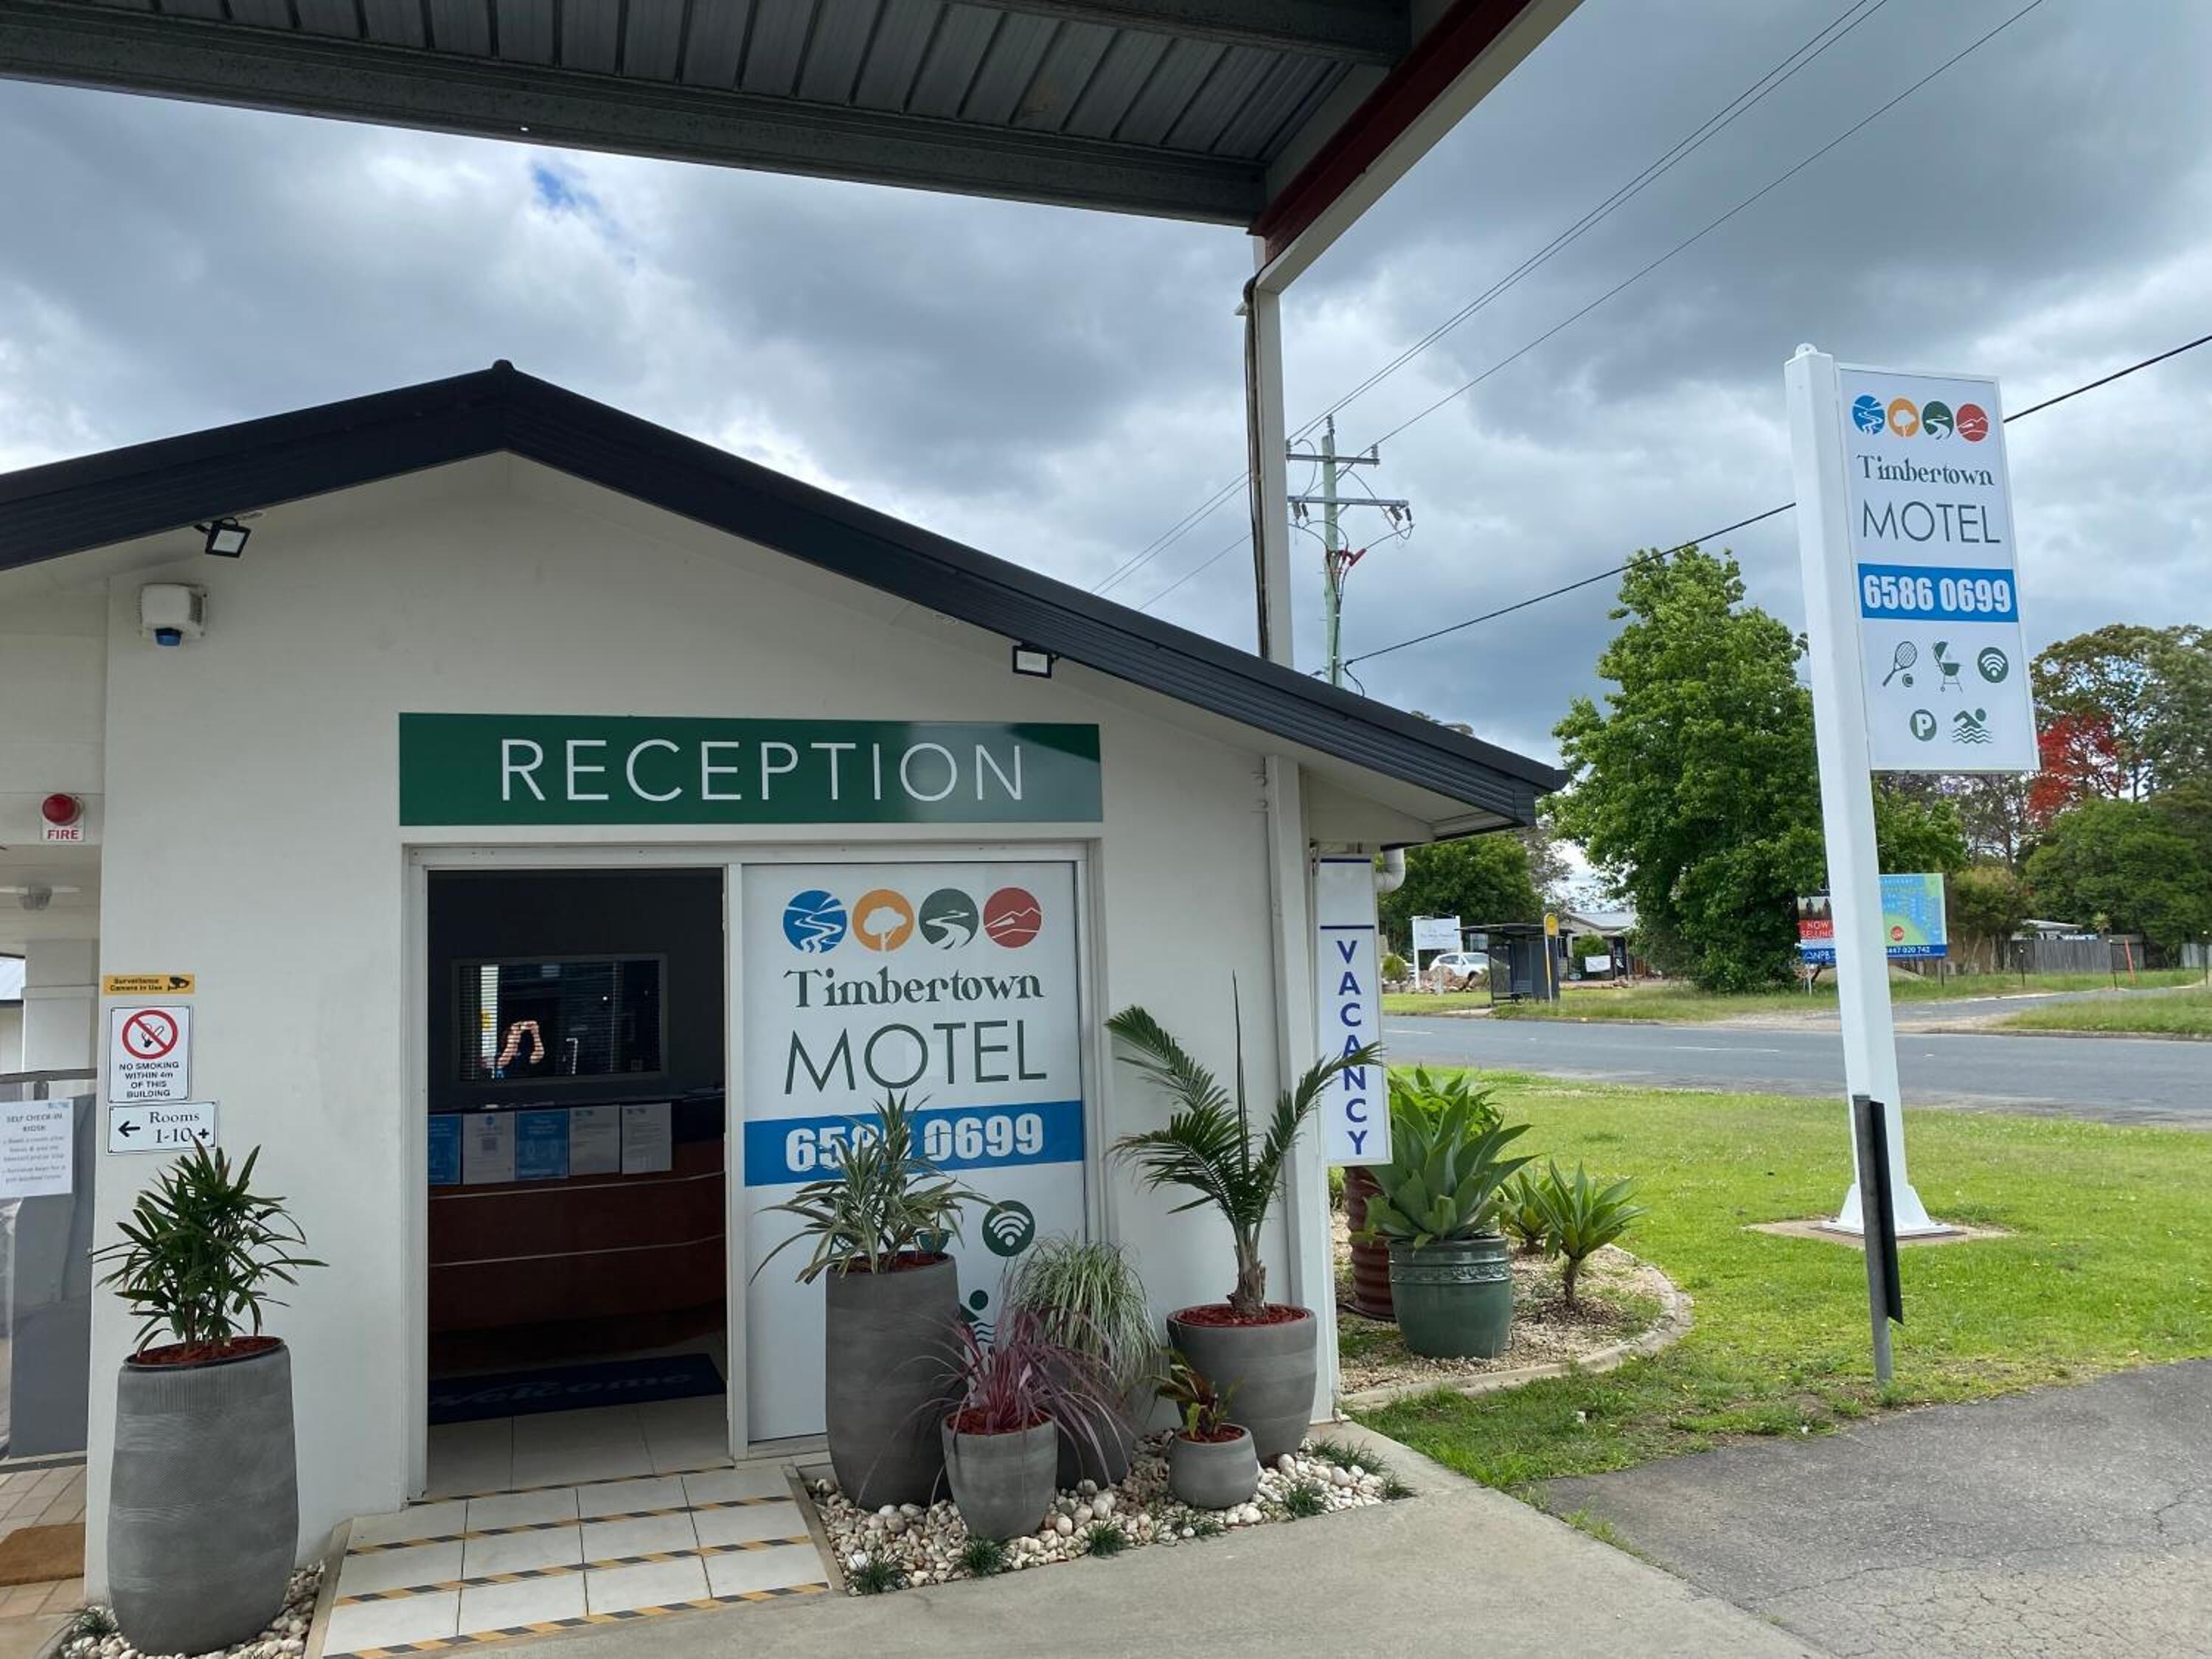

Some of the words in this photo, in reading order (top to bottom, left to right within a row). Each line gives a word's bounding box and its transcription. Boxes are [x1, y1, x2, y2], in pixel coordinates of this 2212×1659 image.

[1857, 454, 1994, 487] Timbertown
[1863, 499, 2001, 543] MOTEL
[1863, 574, 1933, 611] 6586
[1939, 578, 2011, 613] 0699
[1916, 714, 1931, 737] P
[501, 739, 1023, 801] RECEPTION
[47, 830, 79, 840] FIRE
[783, 967, 1044, 1008] Timbertown
[784, 1019, 1047, 1095] MOTEL
[1336, 939, 1368, 1156] VACANCY
[119, 1062, 133, 1071] NO
[136, 1061, 179, 1070] SMOKING
[126, 1089, 170, 1098] BUILDING
[131, 1081, 144, 1089] OF
[146, 1080, 167, 1088] THIS
[149, 1111, 200, 1124] Rooms
[156, 1127, 192, 1144] 1-10
[923, 1113, 1044, 1164] 0699
